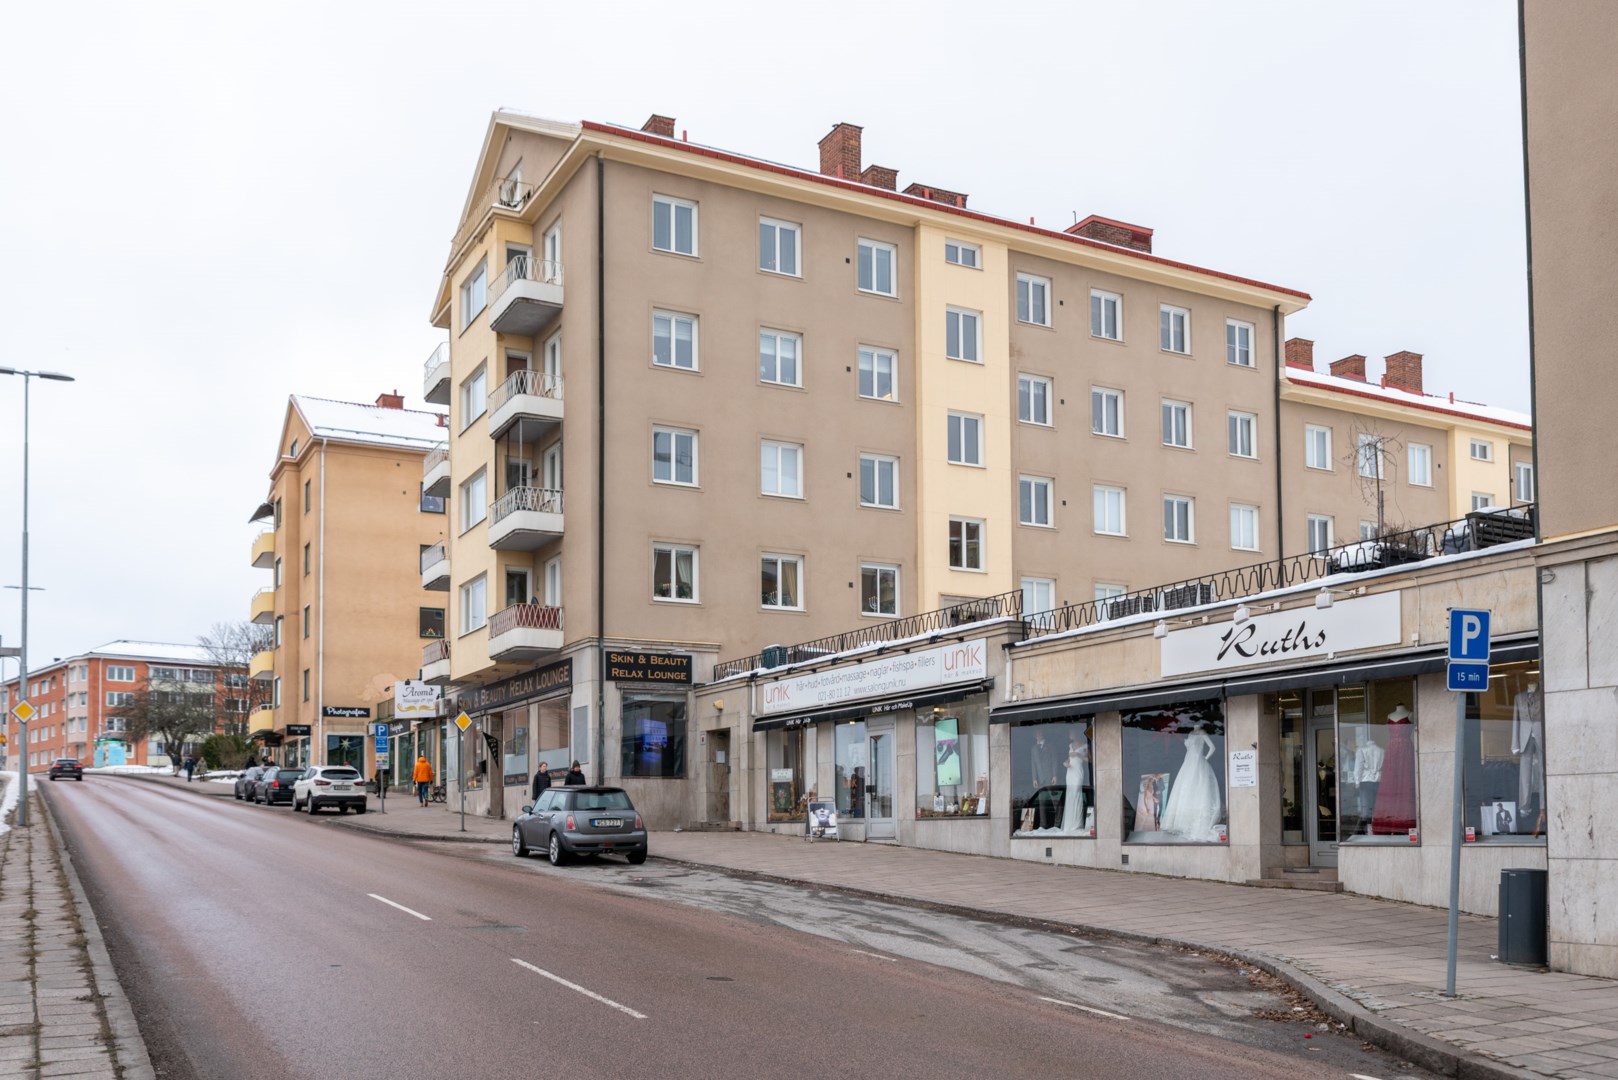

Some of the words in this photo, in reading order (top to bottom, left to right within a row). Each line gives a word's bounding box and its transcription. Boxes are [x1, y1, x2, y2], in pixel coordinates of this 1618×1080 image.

[1217, 620, 1326, 660] Ruths
[1462, 614, 1481, 655] P
[638, 655, 646, 664] &
[1458, 672, 1466, 681] 15
[1468, 672, 1480, 681] min
[402, 686, 434, 698] Aroma
[378, 726, 385, 736] P
